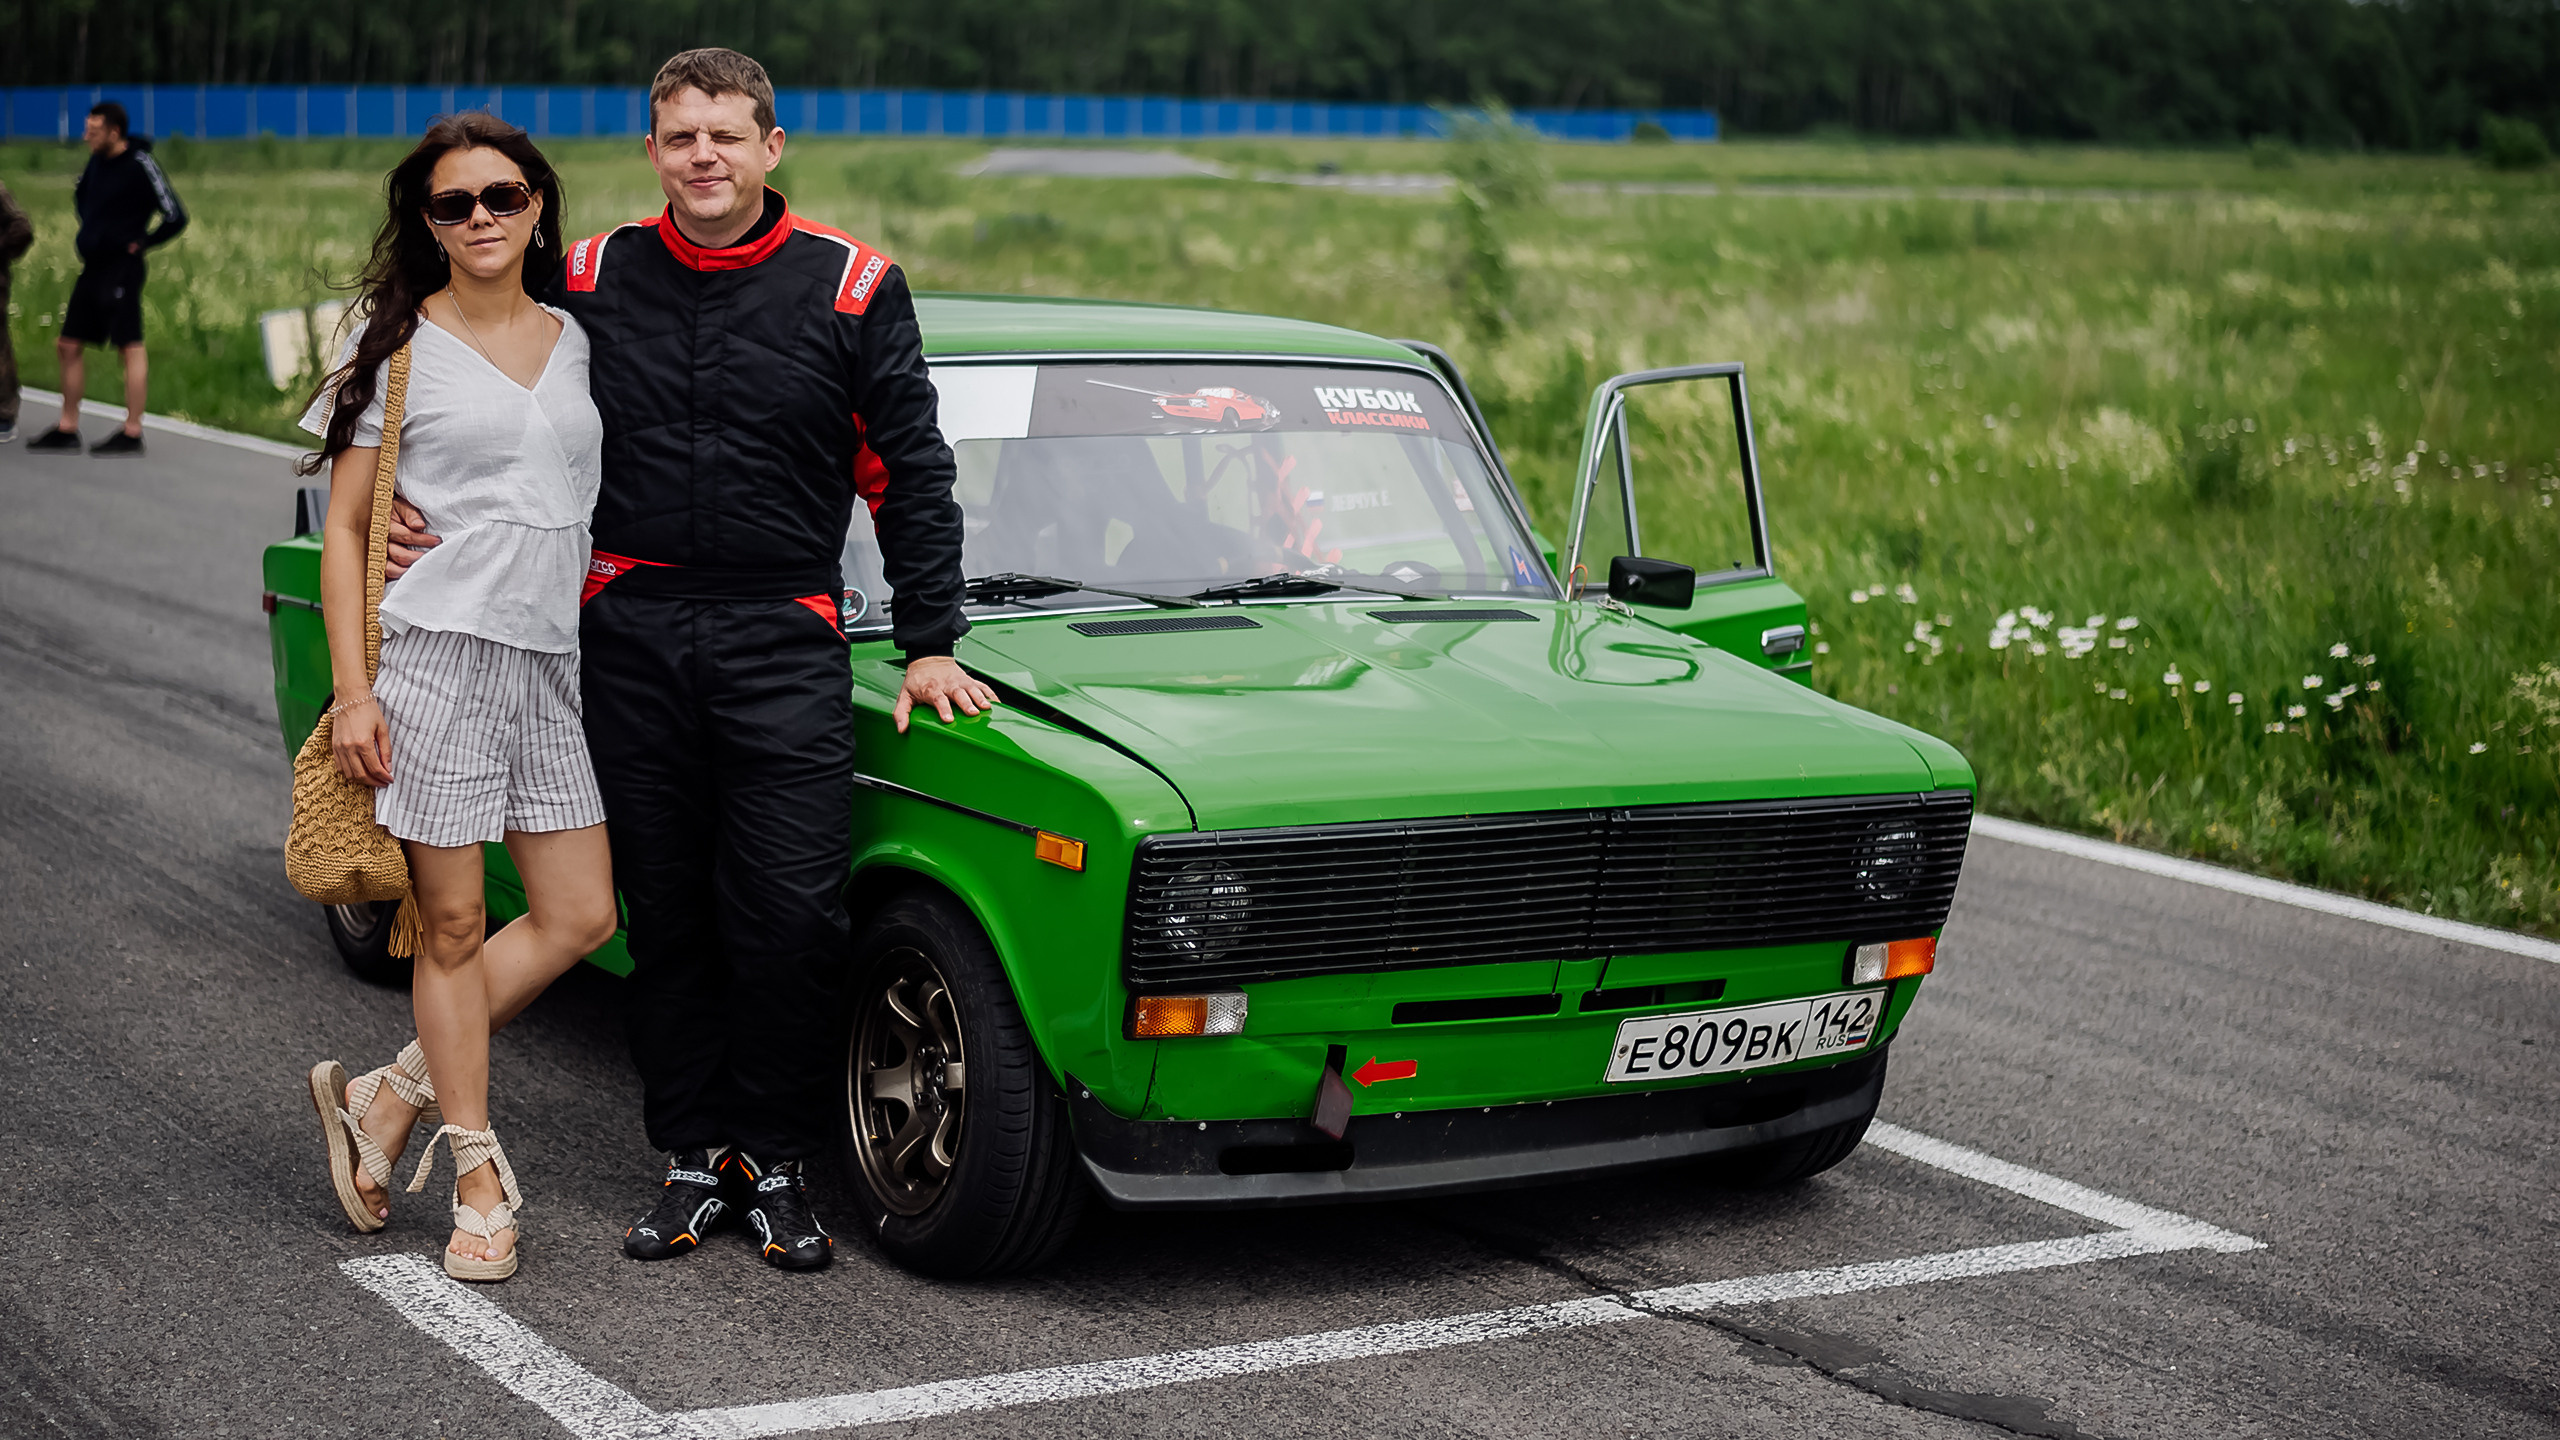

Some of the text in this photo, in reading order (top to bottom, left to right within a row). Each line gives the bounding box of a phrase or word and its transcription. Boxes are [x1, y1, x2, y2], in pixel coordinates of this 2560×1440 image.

[851, 255, 884, 301] sparco
[1313, 386, 1423, 413] КУБОК
[1327, 411, 1430, 430] КЛАССИКИ
[590, 558, 616, 575] arco
[1625, 998, 1872, 1074] Е809ВК 142
[1816, 1035, 1846, 1050] RUS
